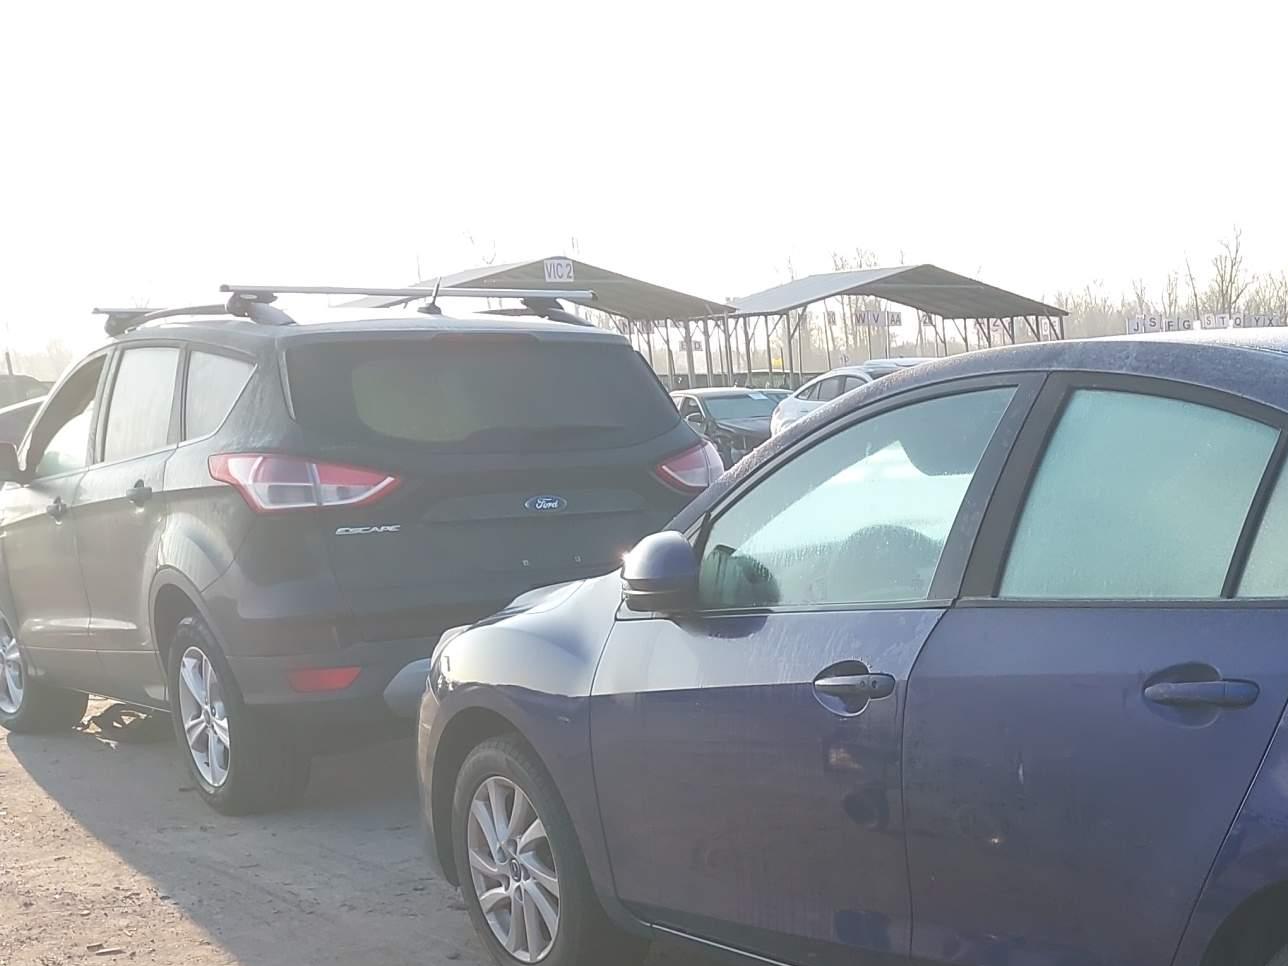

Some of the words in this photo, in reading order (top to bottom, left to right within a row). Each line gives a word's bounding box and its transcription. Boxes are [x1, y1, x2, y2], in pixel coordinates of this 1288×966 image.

[545, 262, 564, 279] VIC
[565, 262, 573, 279] 2
[1149, 317, 1156, 327] S
[1219, 316, 1226, 325] T
[535, 497, 559, 509] Ford
[336, 524, 400, 535] ESCAPE
